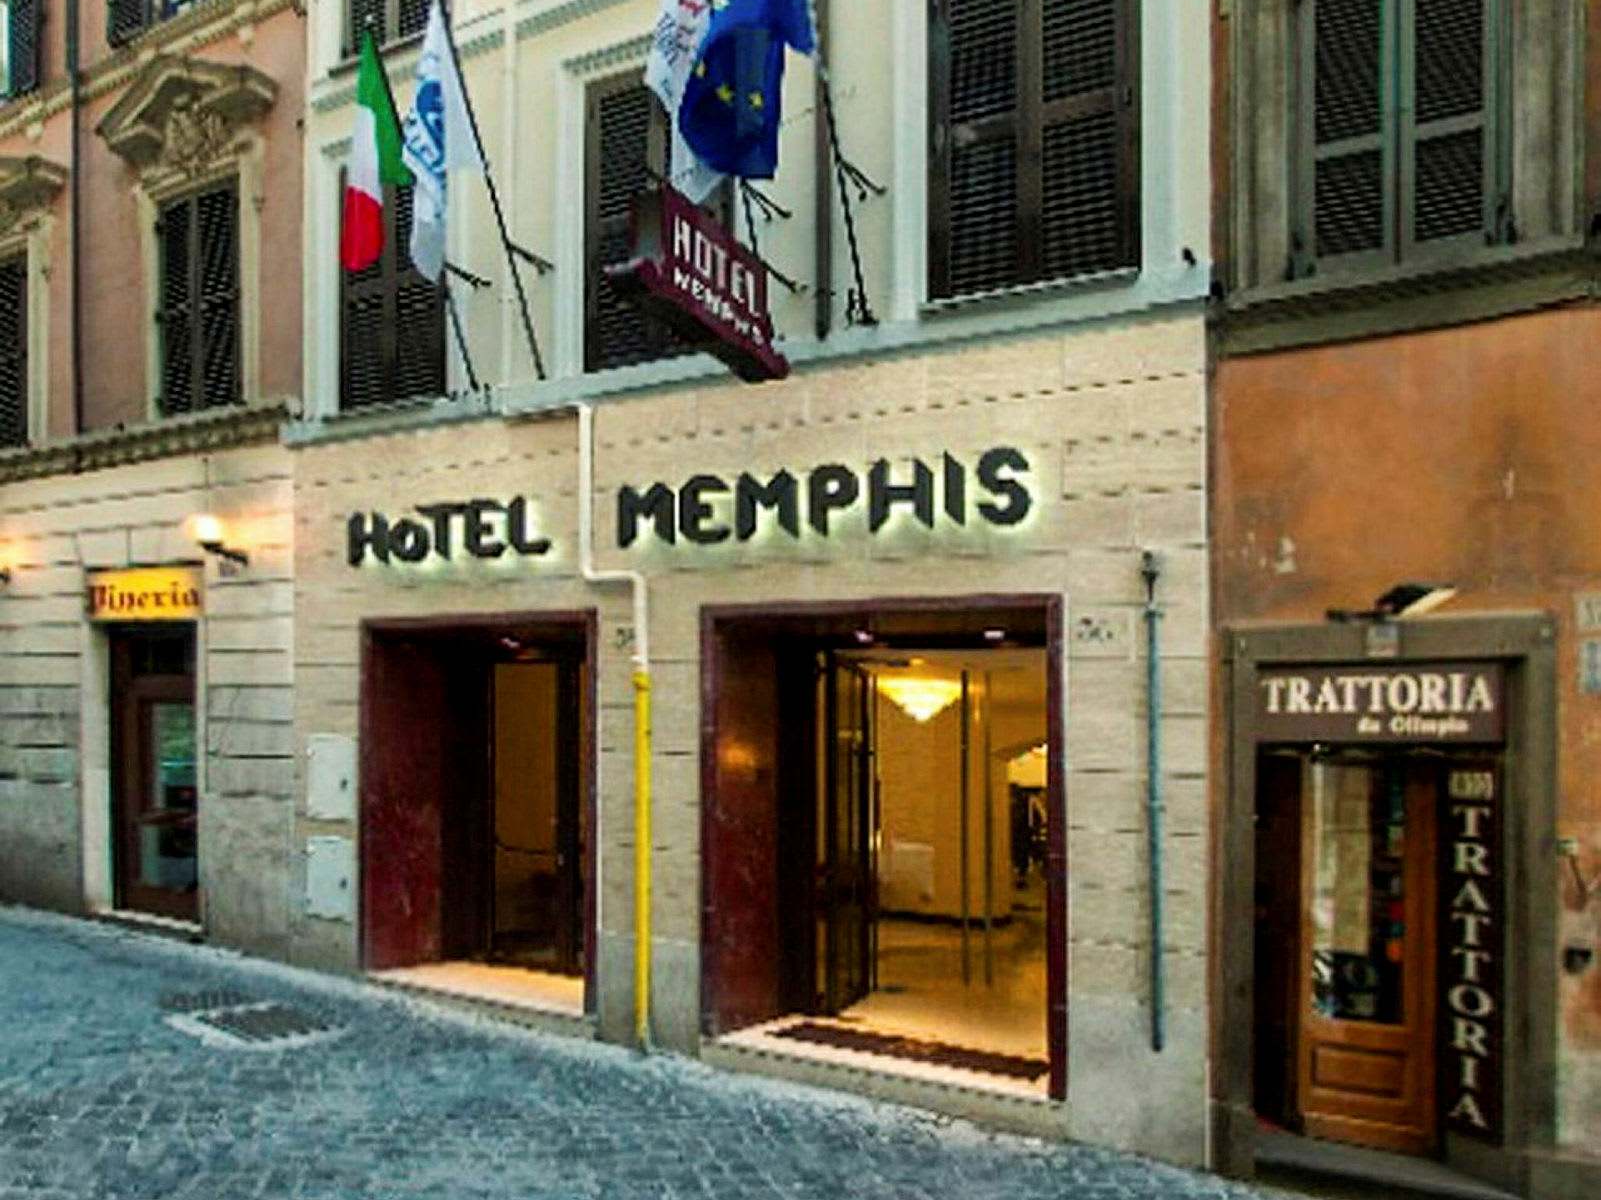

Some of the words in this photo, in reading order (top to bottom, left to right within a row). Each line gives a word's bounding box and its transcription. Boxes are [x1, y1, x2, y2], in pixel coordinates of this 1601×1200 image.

[673, 213, 761, 319] HOTEL
[348, 495, 551, 567] HOTEL
[617, 446, 1033, 549] MEMPHIS
[1262, 673, 1494, 713] TRATTORIA
[1448, 805, 1494, 1130] TRATTORIA
